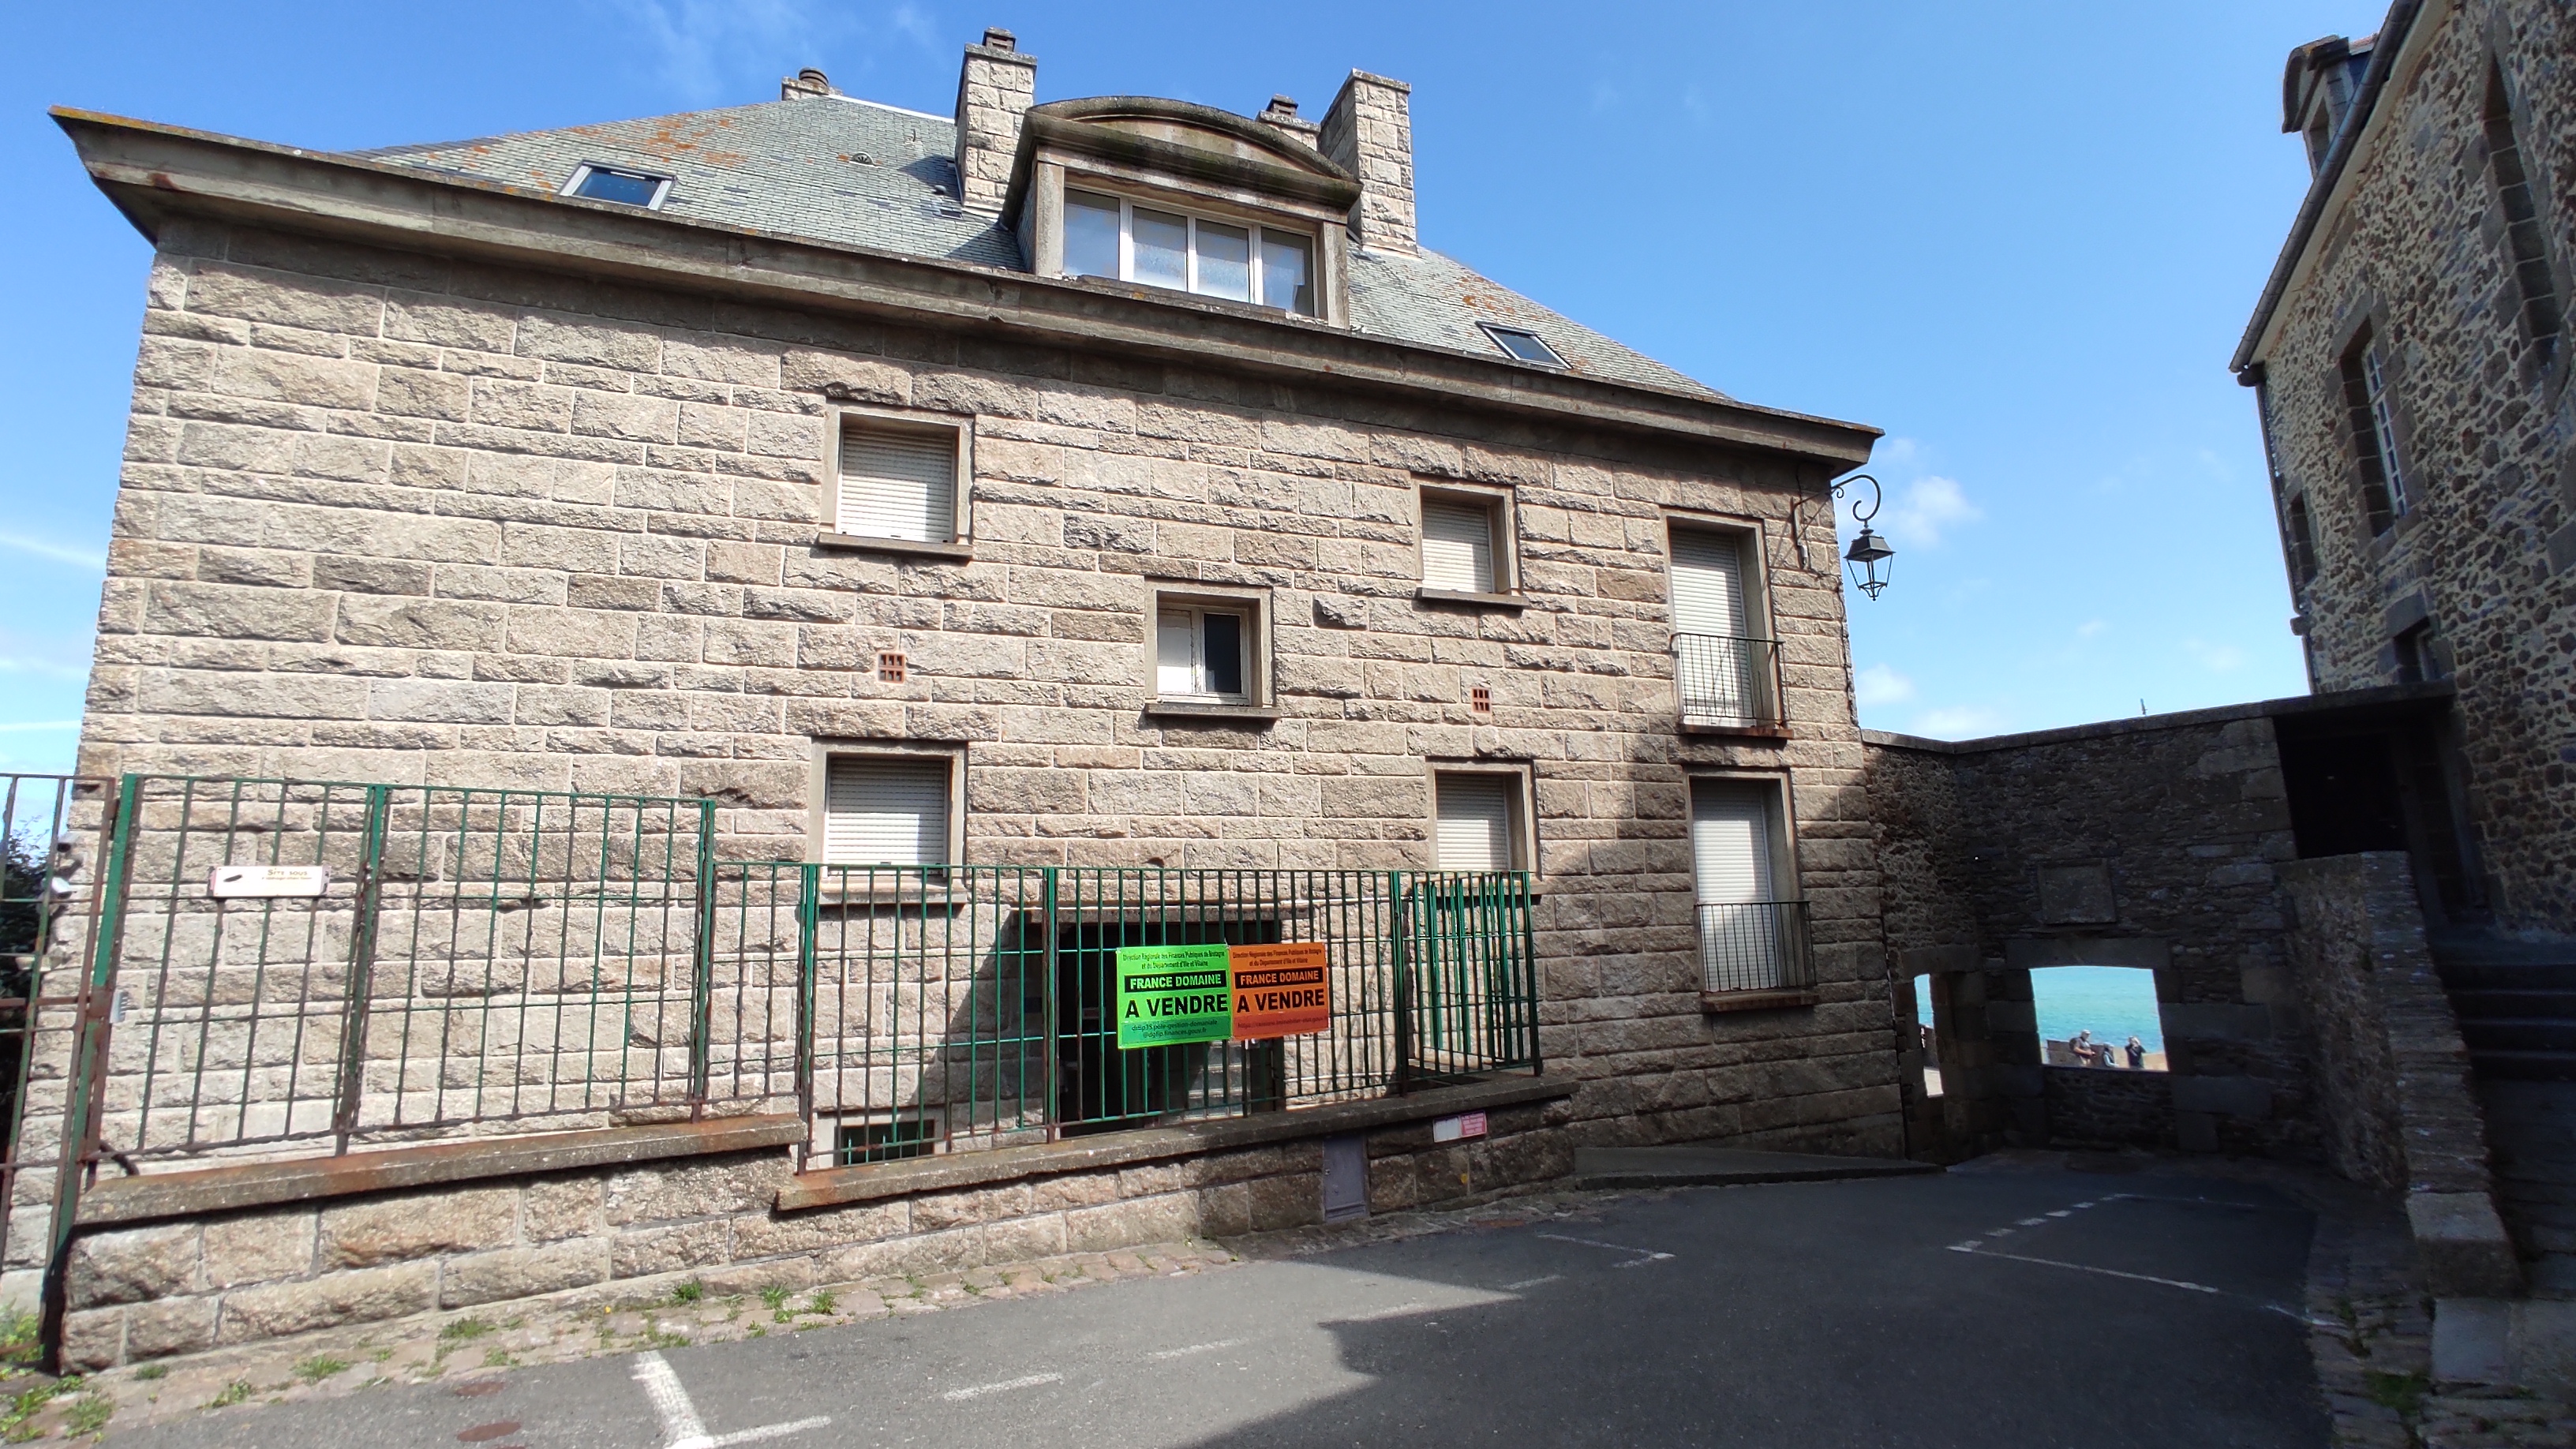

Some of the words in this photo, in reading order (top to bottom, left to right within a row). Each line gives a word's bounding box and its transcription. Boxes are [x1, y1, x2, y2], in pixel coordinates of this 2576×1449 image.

[1130, 976, 1173, 990] FRANCE
[1175, 973, 1222, 987] DOMAINE
[1240, 973, 1278, 986] FRANCE
[1279, 970, 1320, 983] DOMAINE
[1125, 998, 1140, 1018] A
[1146, 994, 1228, 1017] VENDRE
[1237, 994, 1250, 1013] A
[1254, 989, 1325, 1011] VENDRE
